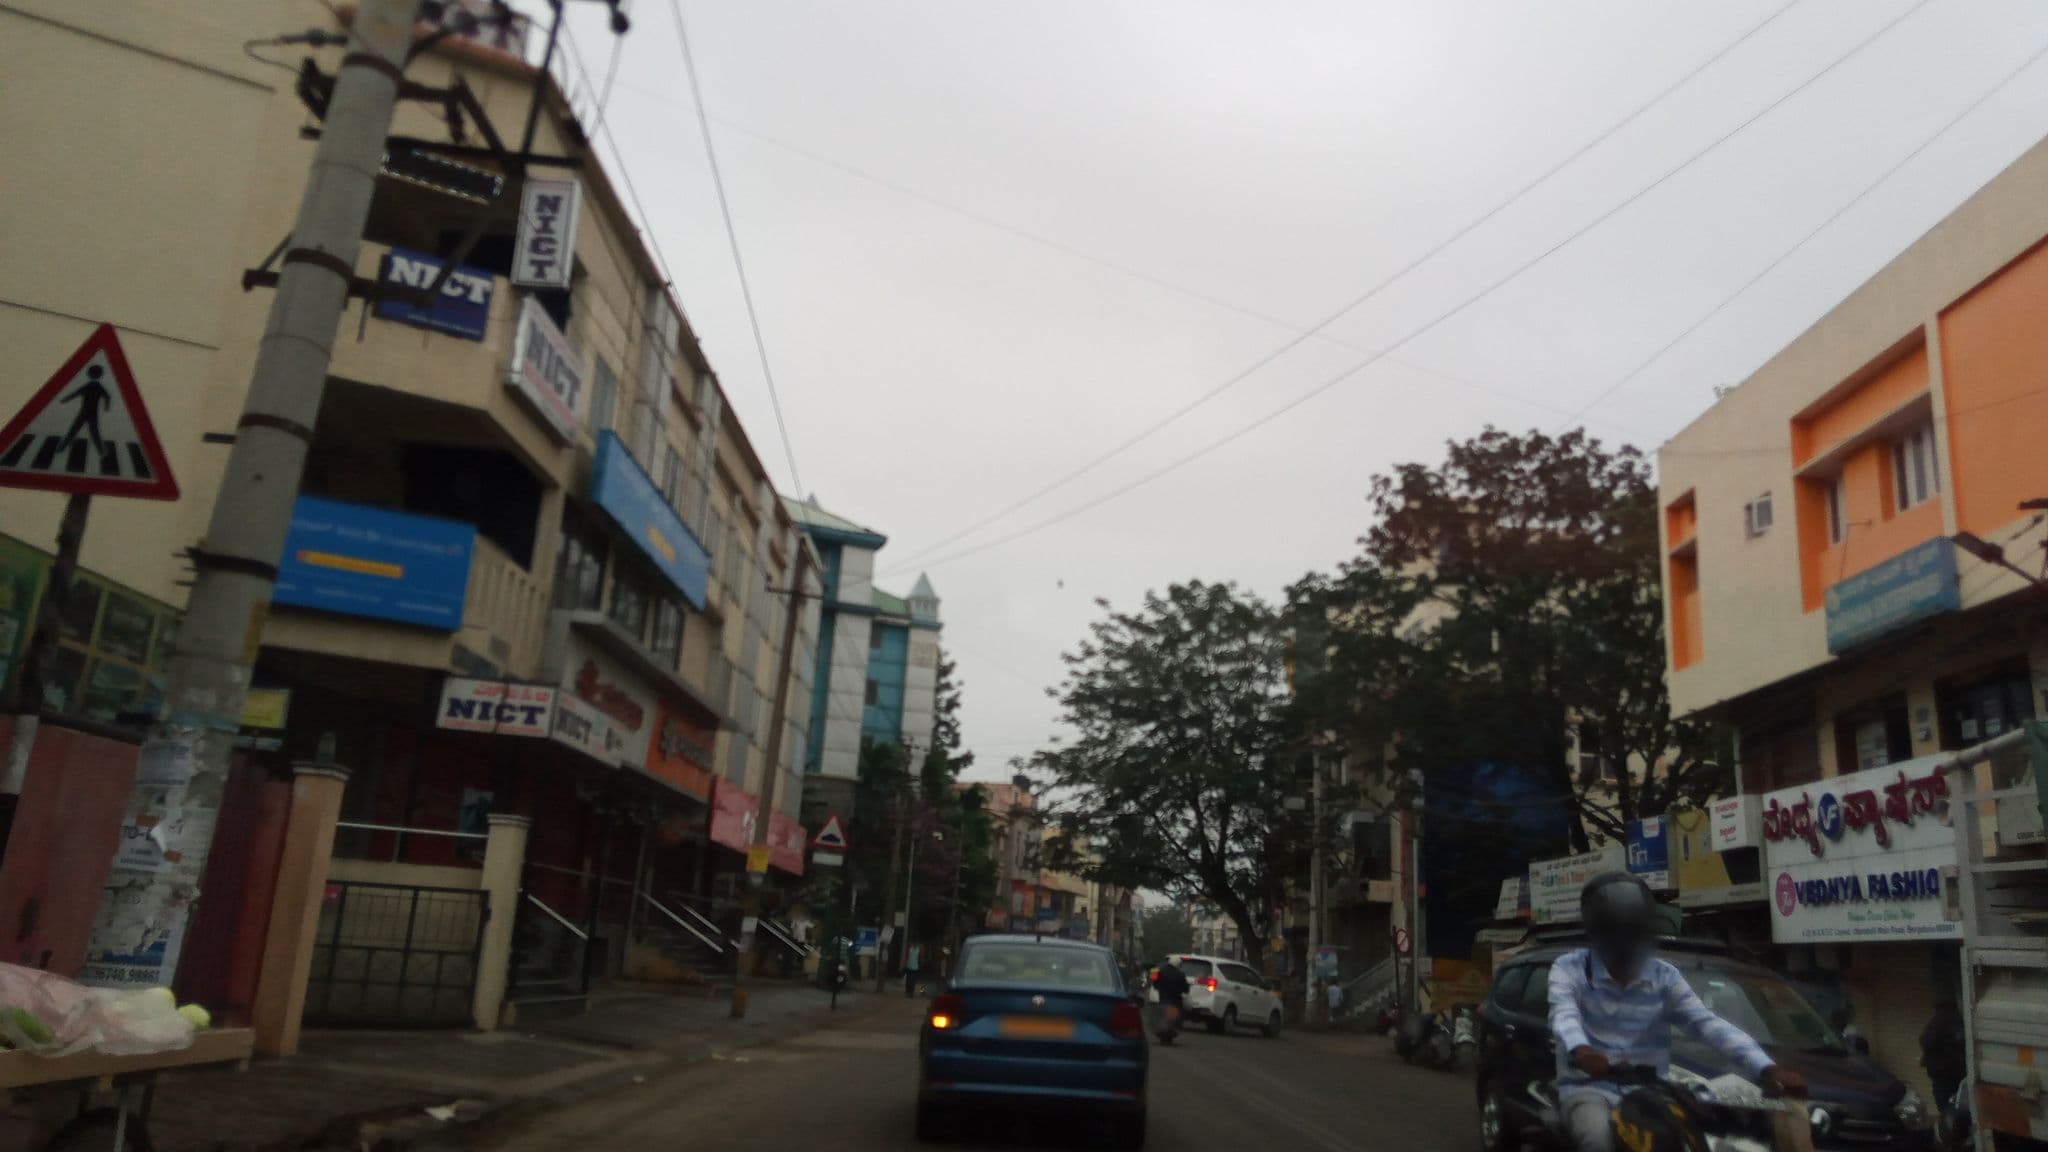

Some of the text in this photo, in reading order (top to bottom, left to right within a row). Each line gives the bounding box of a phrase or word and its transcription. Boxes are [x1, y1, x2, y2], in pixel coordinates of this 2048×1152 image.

[528, 194, 562, 279] NICT
[388, 256, 493, 304] NICT
[527, 320, 582, 410] NICT
[447, 698, 545, 725] NICT
[1867, 868, 1940, 899] FASHIO
